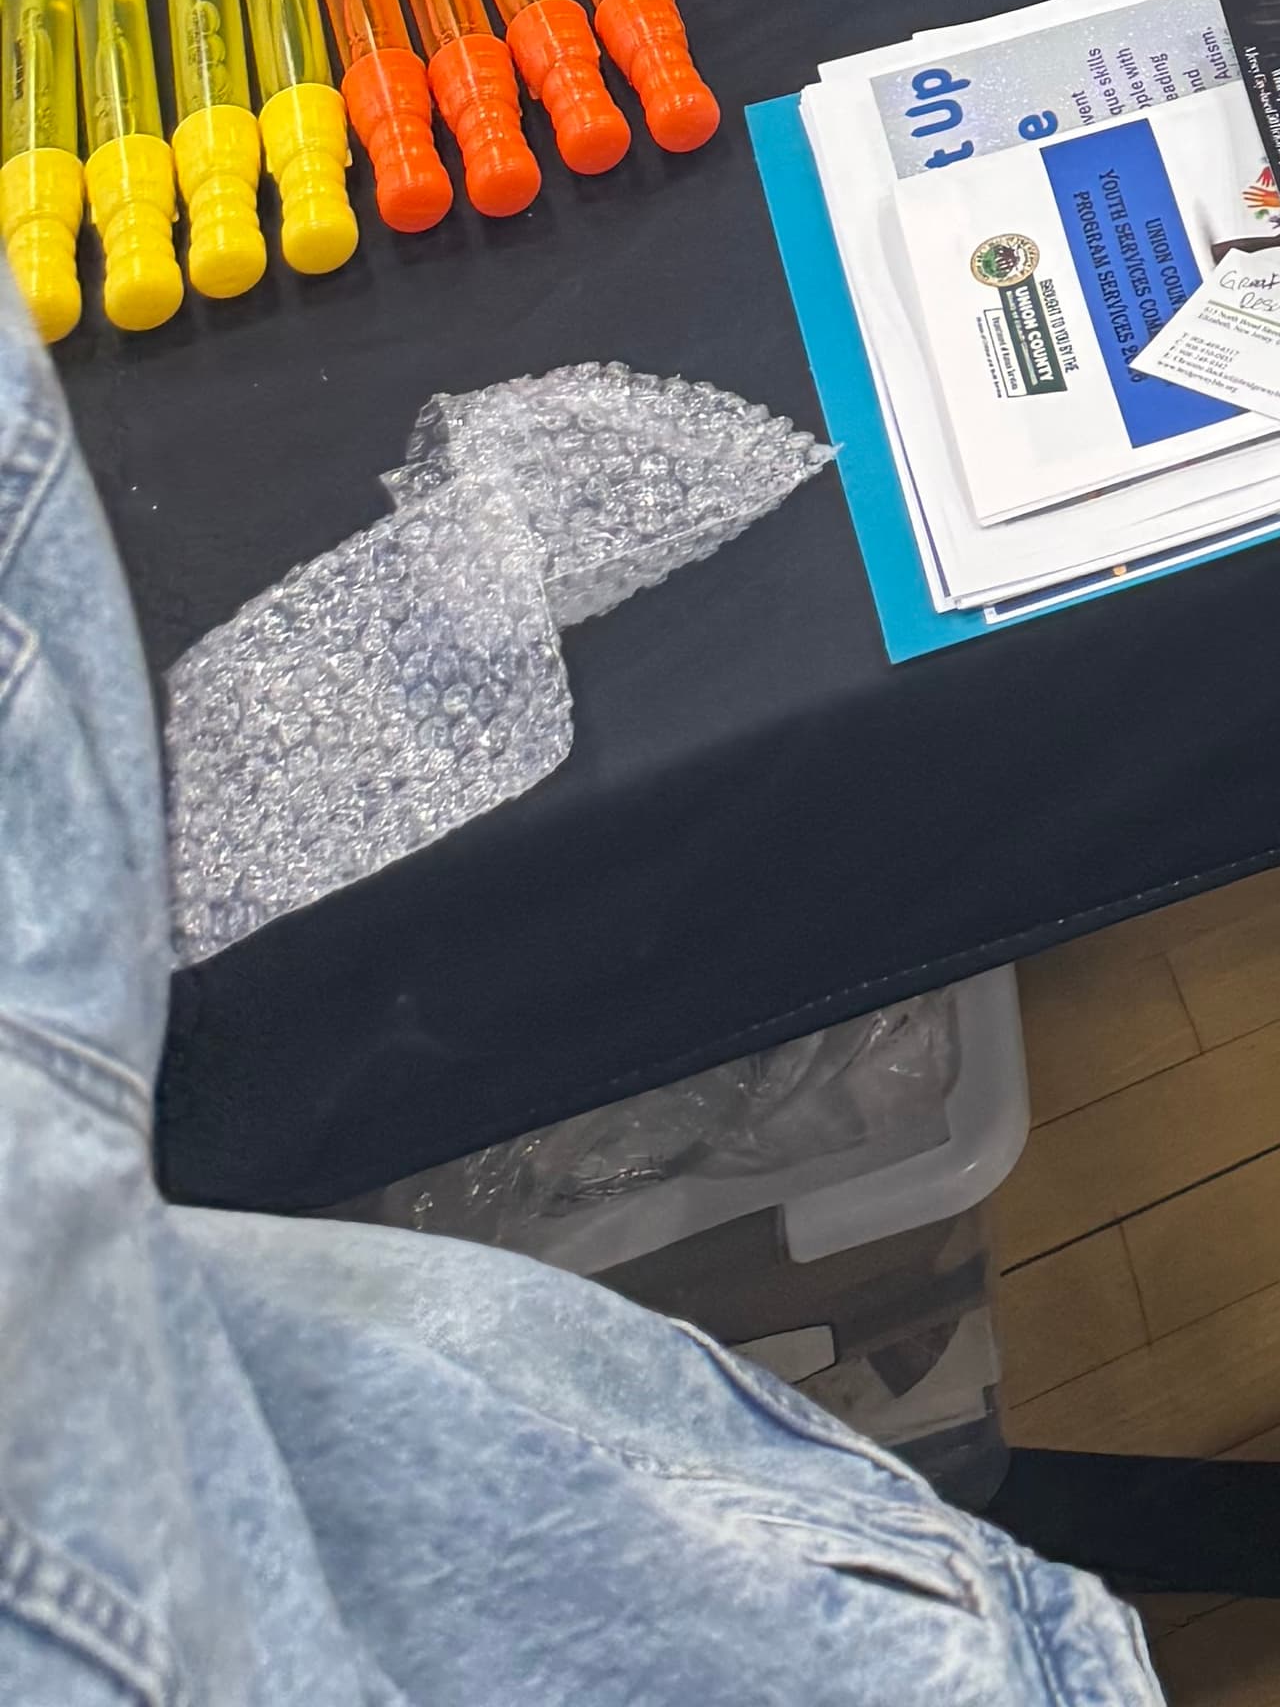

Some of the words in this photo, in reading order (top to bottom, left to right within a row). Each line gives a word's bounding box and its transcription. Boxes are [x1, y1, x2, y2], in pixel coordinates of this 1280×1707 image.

[1085, 45, 1112, 87] skills
[1114, 46, 1140, 80] with
[1199, 23, 1232, 81] Autism.
[1149, 51, 1178, 102] eading
[896, 60, 980, 139] Up
[1071, 89, 1096, 127] vent
[1097, 167, 1130, 222] YOUTH
[1113, 220, 1154, 297] SERVICES
[1144, 217, 1173, 265] UNION
[1072, 189, 1111, 269] PROGRAM
[1097, 268, 1137, 344] SERVICES
[1039, 278, 1062, 316] BROUGHT
[1013, 285, 1038, 330] UNION
[1026, 329, 1053, 383] COUNTY
[1050, 317, 1065, 329] TO
[1053, 327, 1070, 345] YOU
[1058, 344, 1073, 356] BY
[1061, 356, 1079, 373] THE
